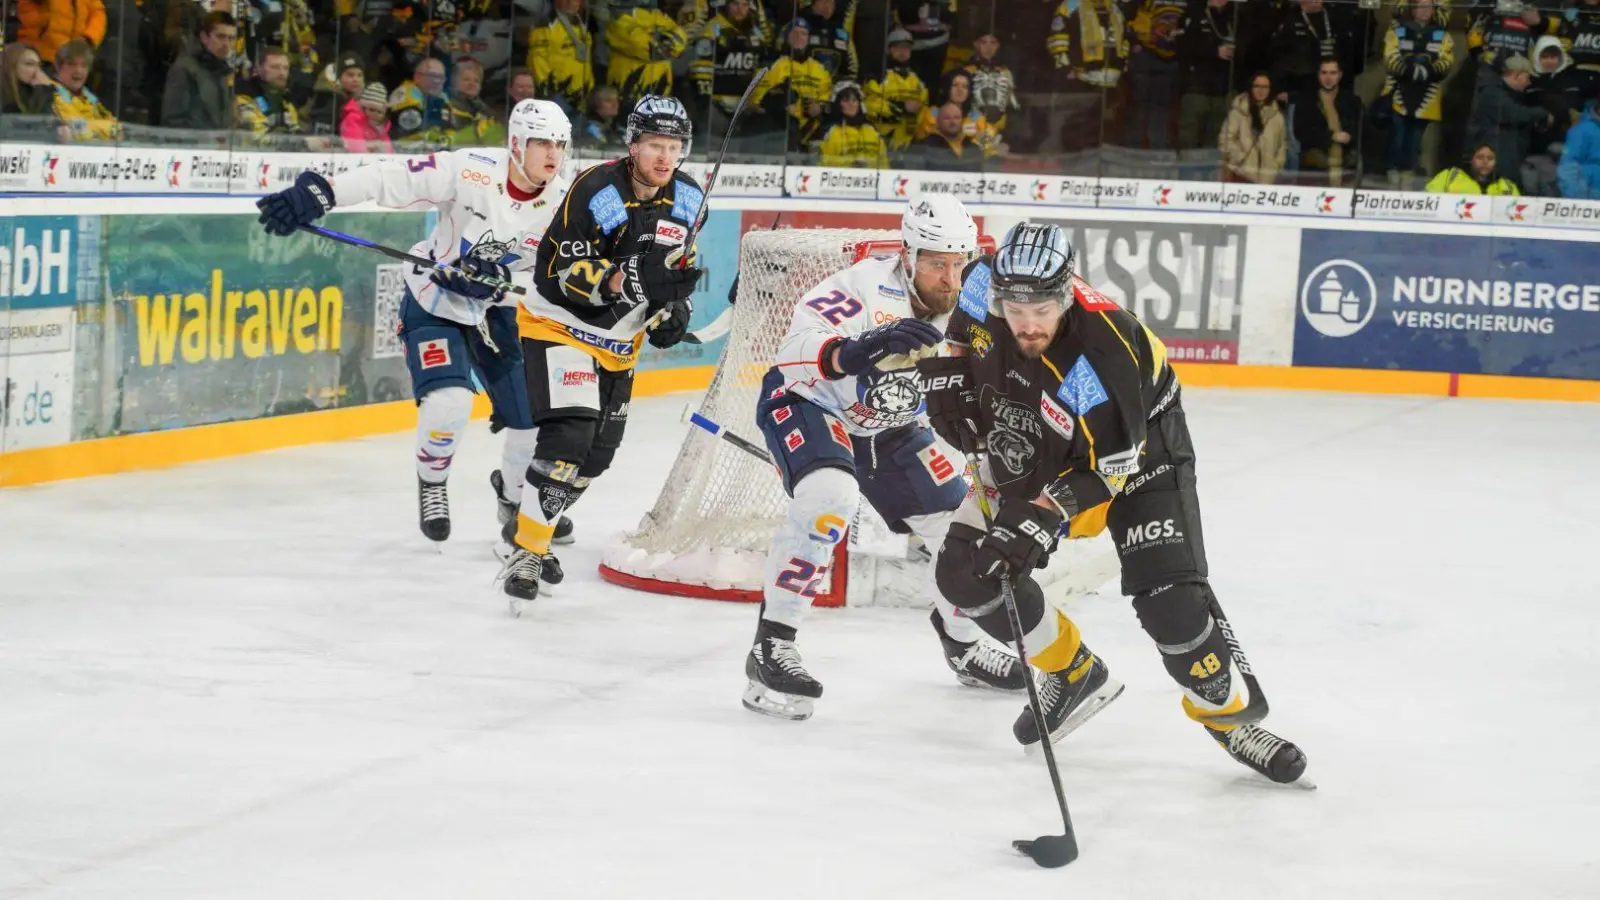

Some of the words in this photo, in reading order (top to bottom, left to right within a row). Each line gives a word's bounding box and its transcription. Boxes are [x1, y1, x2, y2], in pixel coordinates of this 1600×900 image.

[189, 156, 248, 179] Piotrowski
[819, 172, 880, 189] Piotrowski
[919, 176, 1017, 196] www.pio-24.de
[1059, 180, 1139, 198] Piotrowski
[1185, 189, 1300, 207] www.pio-24.de
[1351, 193, 1440, 211] Piotrowski
[1393, 275, 1600, 312] NÜRNBERGE
[136, 269, 344, 367] walraven
[806, 289, 863, 326] 22
[1392, 309, 1555, 334] VERSICHERUNG
[549, 460, 577, 482] 27
[1189, 652, 1221, 678] 48
